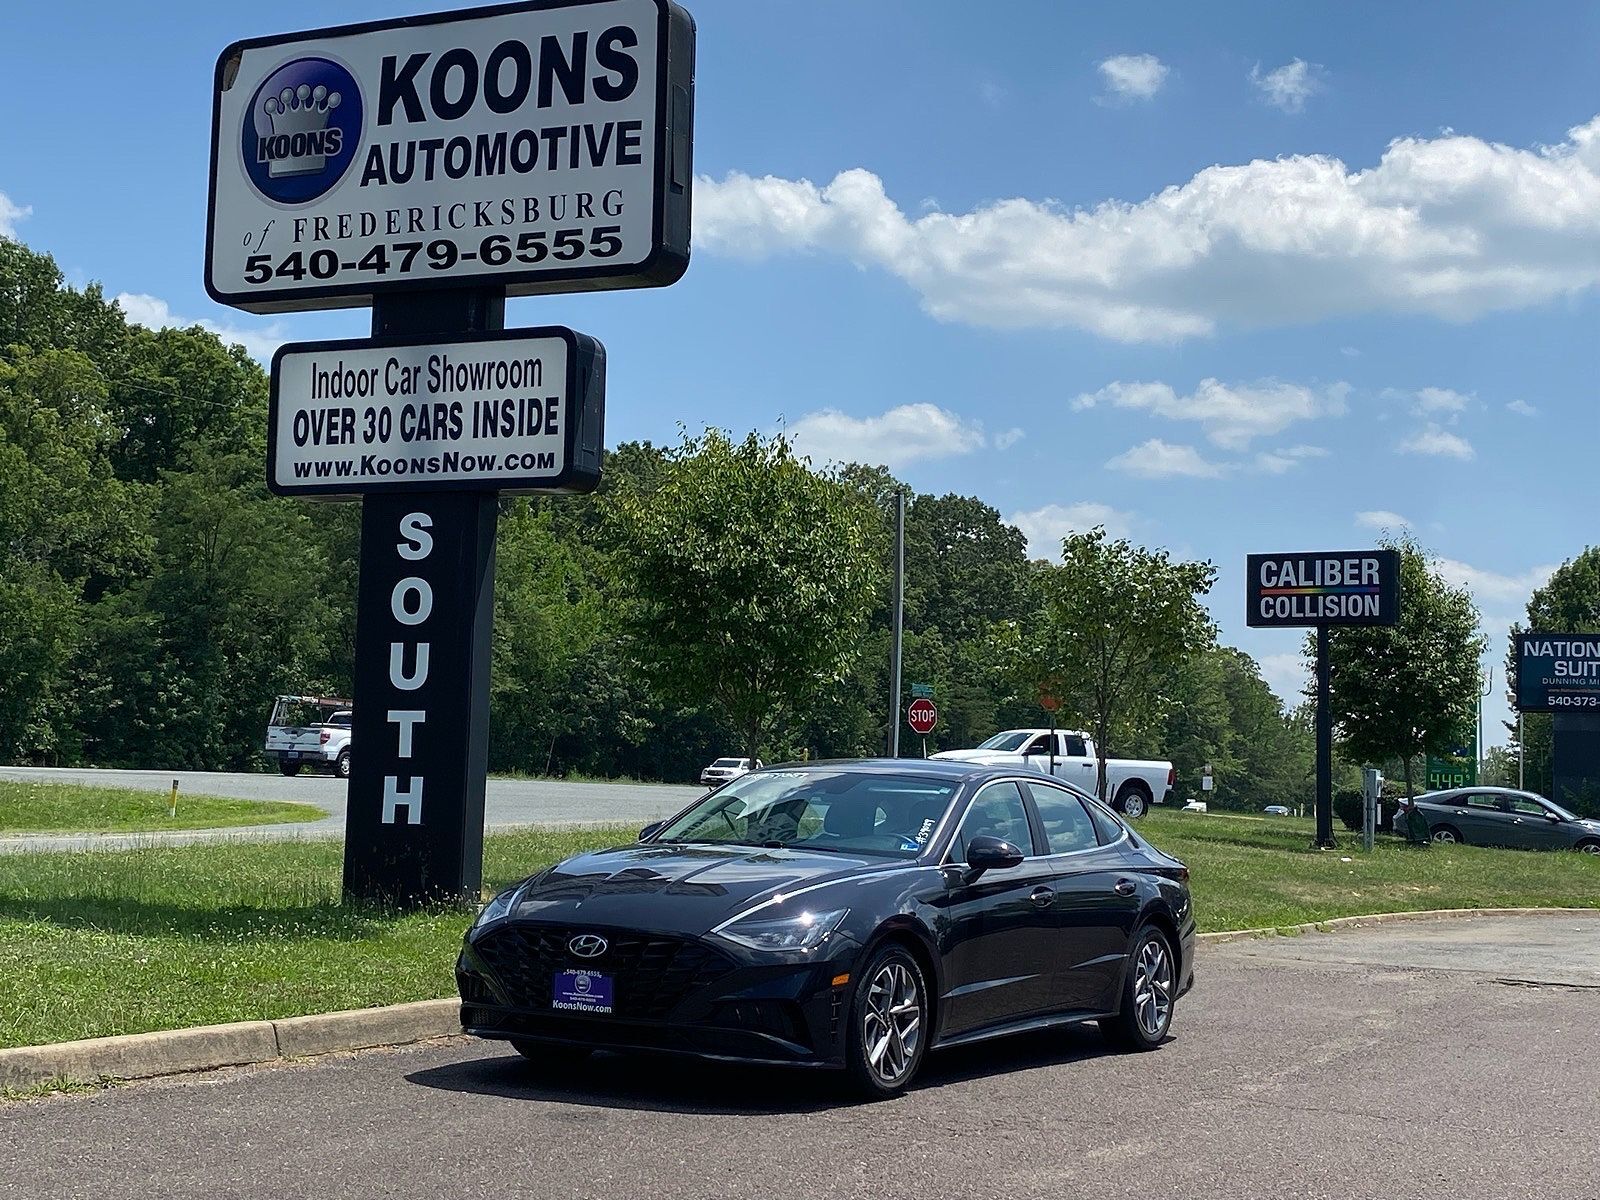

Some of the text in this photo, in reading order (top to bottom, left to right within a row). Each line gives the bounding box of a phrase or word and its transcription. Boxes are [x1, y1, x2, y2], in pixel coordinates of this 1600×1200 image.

[377, 25, 640, 127] KOONS
[257, 128, 343, 163] KOONS
[360, 120, 643, 188] AUTOMOTIVE
[242, 189, 625, 255] of FREDERICKSBURG
[243, 225, 623, 285] 540-479-6555
[311, 354, 542, 399] Indoor Car Showroom
[293, 397, 559, 447] OVER 30 CARS INSIDE
[1260, 558, 1380, 588] CALIBER
[1260, 594, 1380, 619] COLLISION
[382, 512, 433, 824] SOUTH
[911, 709, 934, 723] STOP
[553, 1000, 612, 1013] KoonsNow.com
